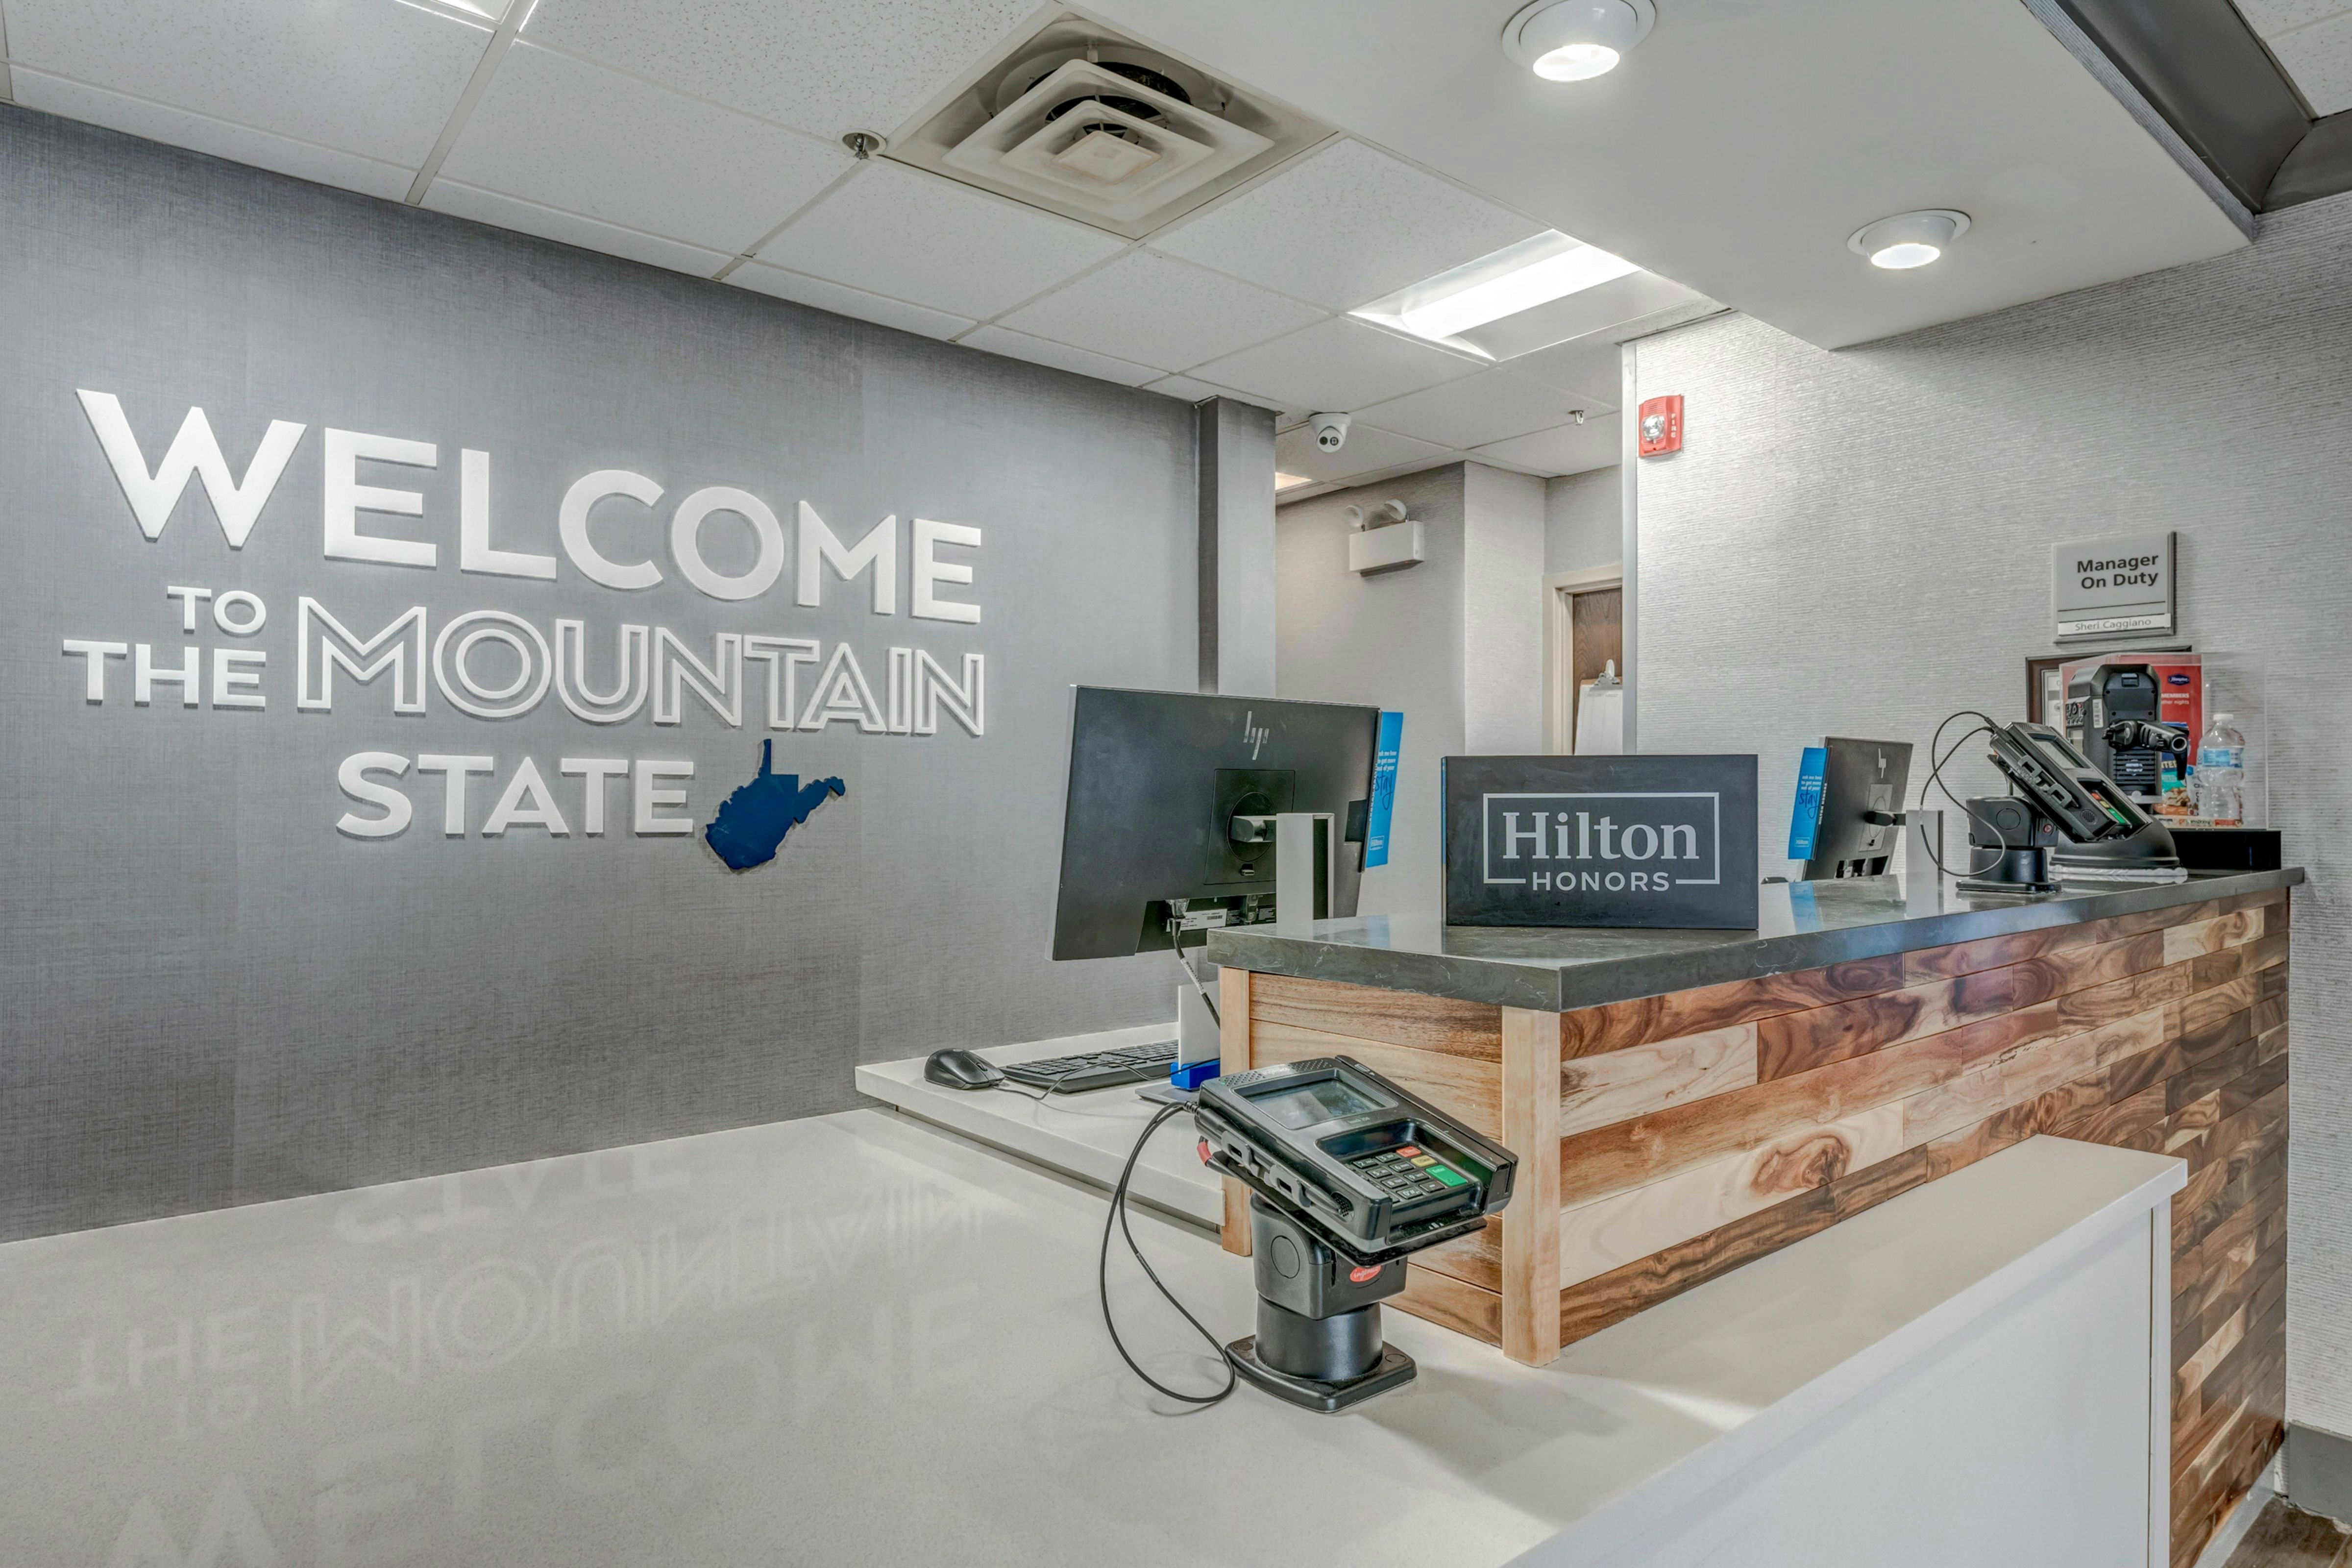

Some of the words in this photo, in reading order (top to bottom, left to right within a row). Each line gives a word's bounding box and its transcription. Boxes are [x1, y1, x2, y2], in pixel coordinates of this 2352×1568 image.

[76, 388, 981, 623] WELCOME
[2077, 555, 2159, 573] Manager
[2081, 577, 2107, 589] On
[2113, 572, 2158, 587] Duty
[167, 585, 267, 636] TO
[2075, 621, 2100, 631] Sheri
[2103, 618, 2152, 630] Caggiano
[62, 639, 266, 709] THE
[297, 596, 984, 736] MOUNTAIN
[336, 751, 694, 837] STATE
[1375, 765, 1393, 810] stay
[1798, 786, 1819, 819] stay
[1502, 811, 1700, 860] Hilton
[1532, 871, 1670, 891] HONORS
